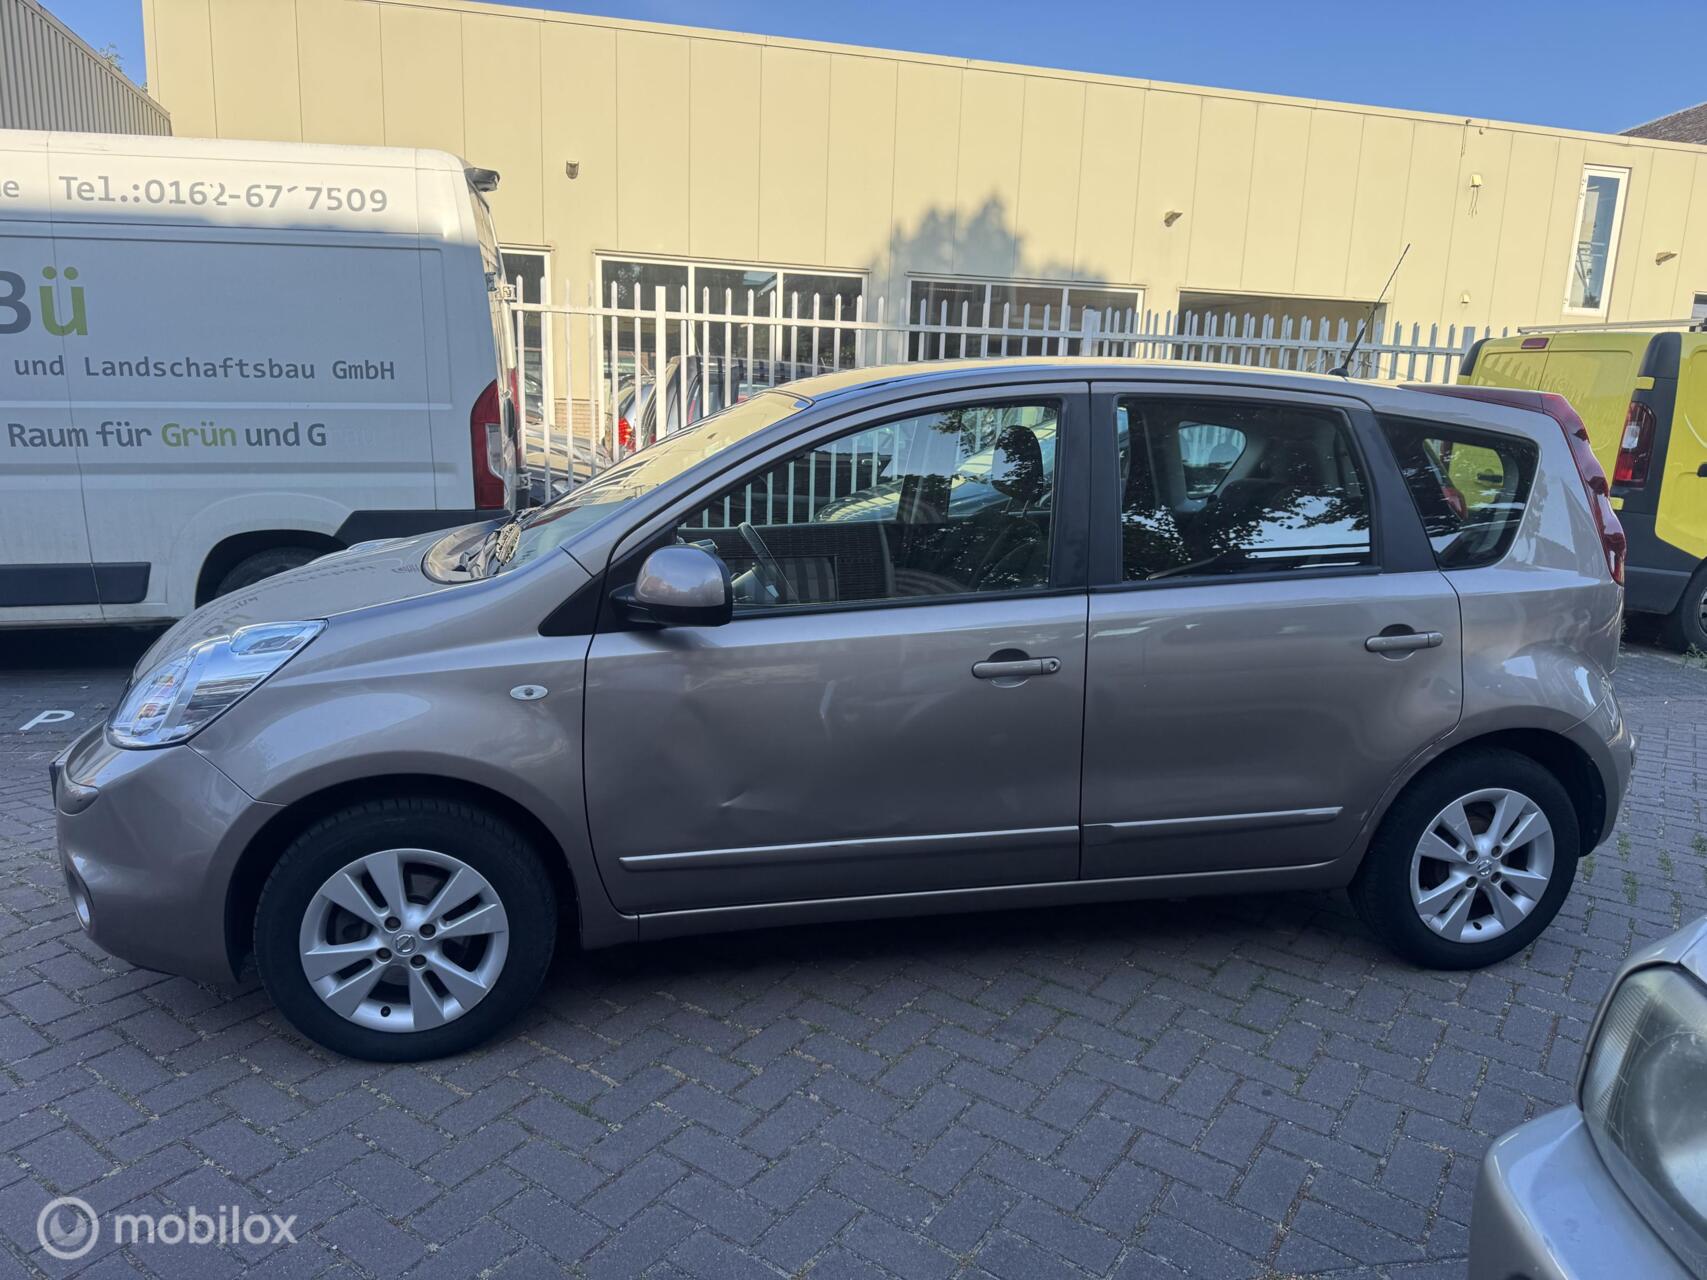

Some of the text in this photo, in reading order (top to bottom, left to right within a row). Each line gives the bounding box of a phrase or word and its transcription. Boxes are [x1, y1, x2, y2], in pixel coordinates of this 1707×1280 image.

[0, 180, 20, 198] e
[14, 355, 395, 380] und Landschaftsbau GmbH
[7, 423, 89, 448] Raum
[96, 421, 152, 447] für
[161, 421, 237, 447] Grün
[245, 422, 301, 447] und
[19, 709, 75, 731] P
